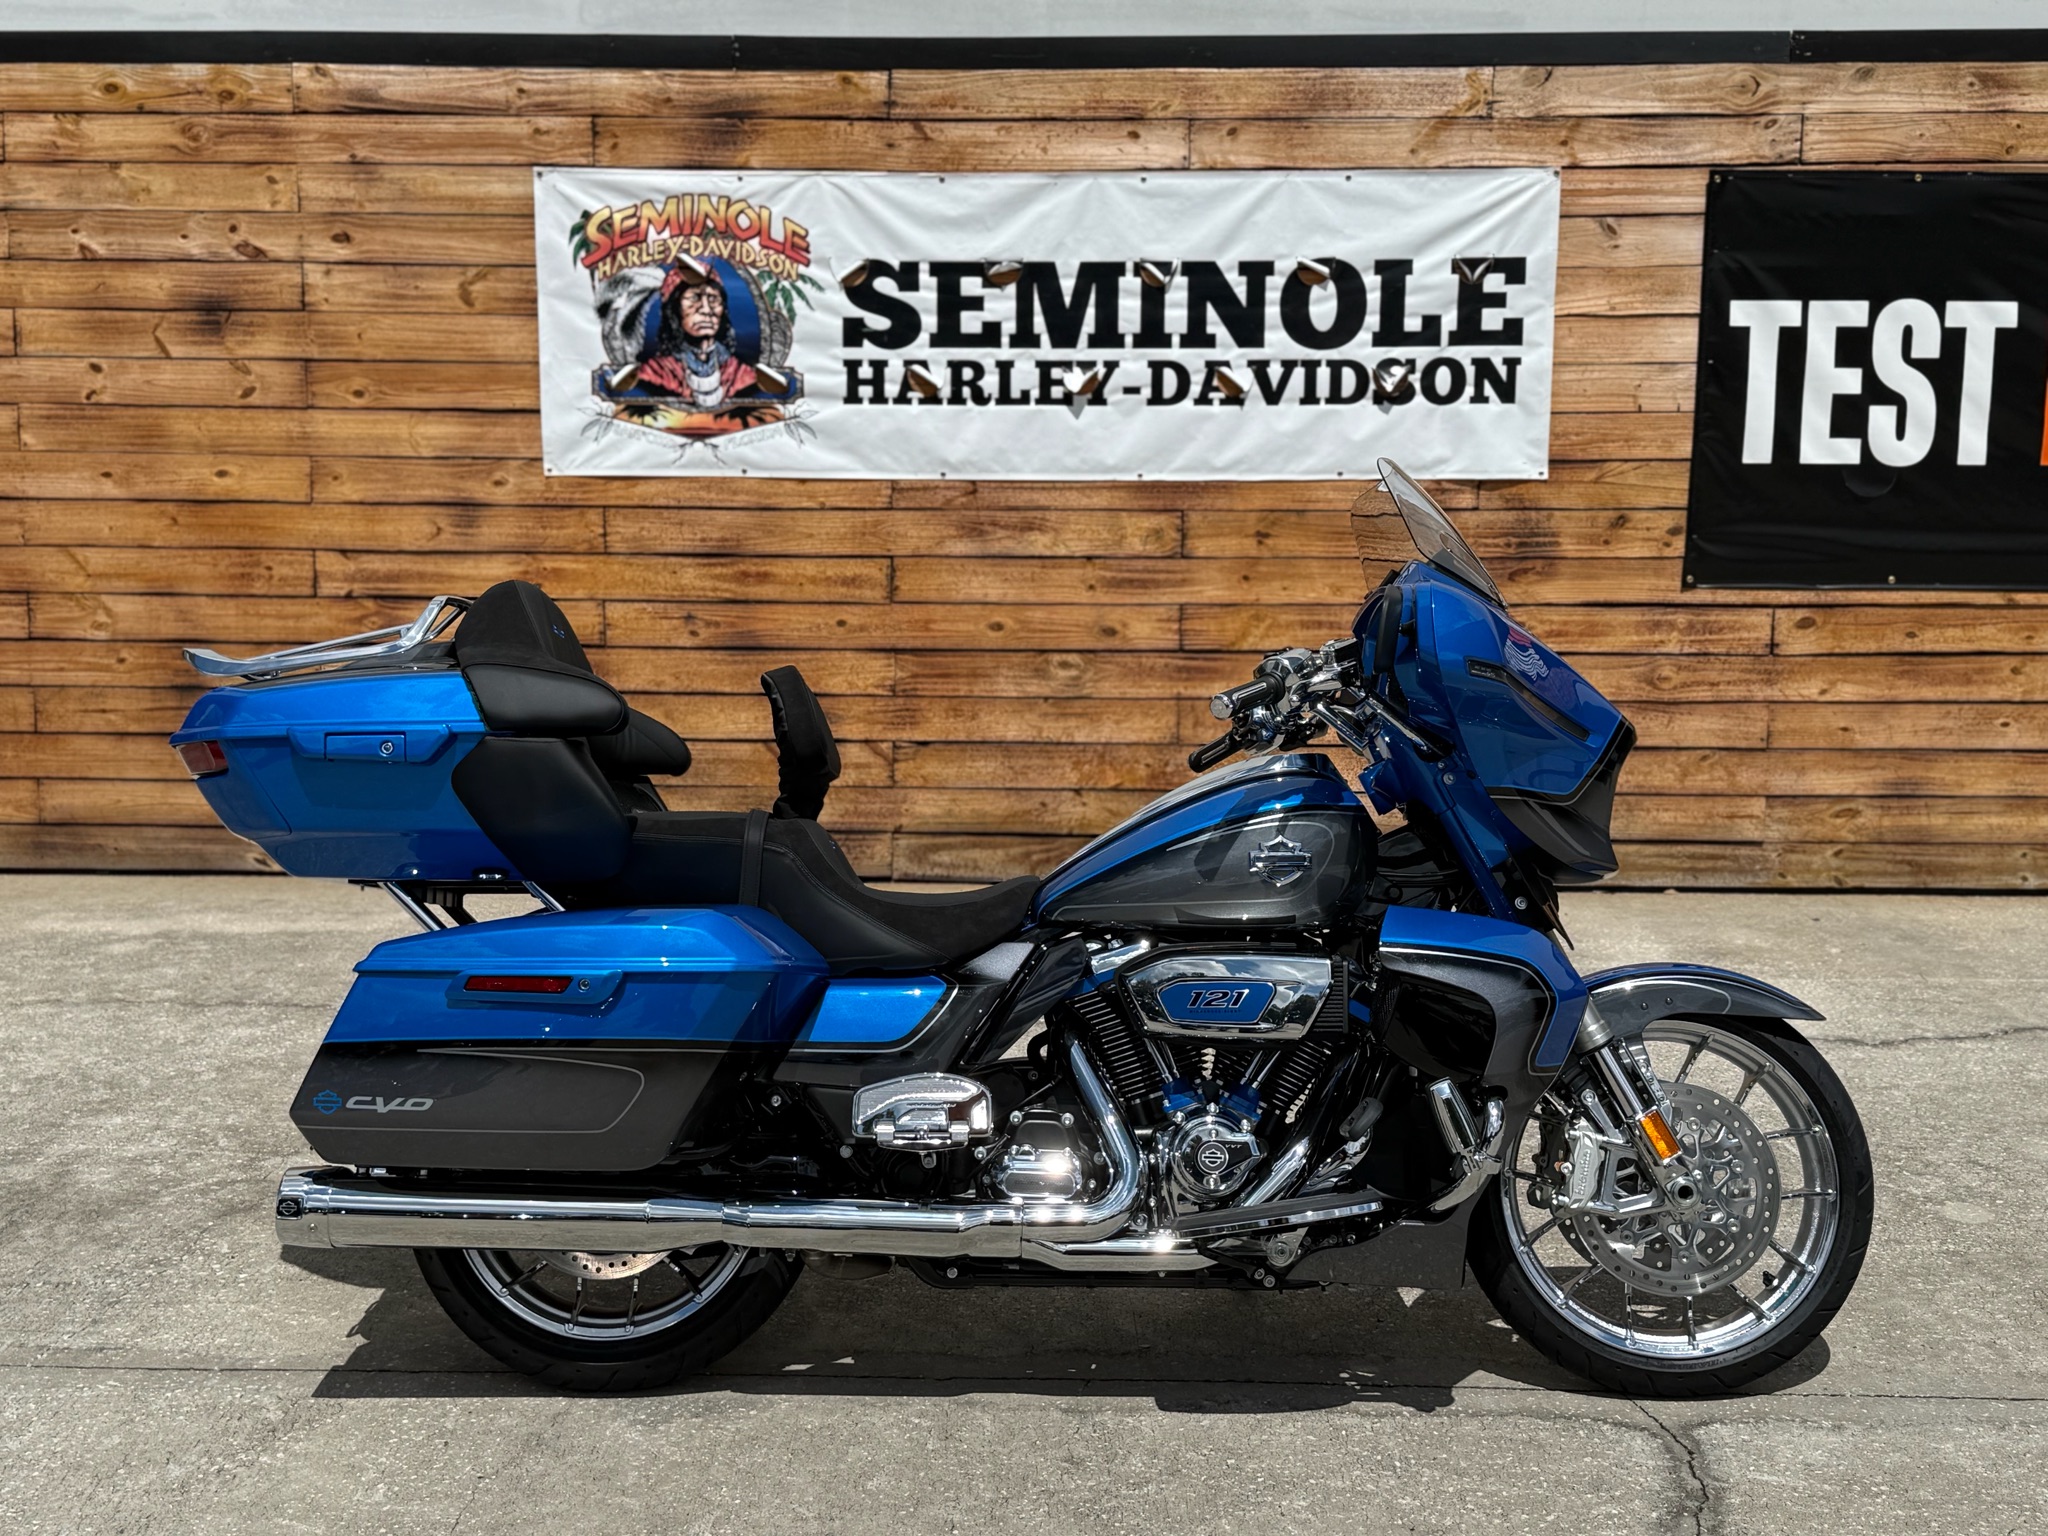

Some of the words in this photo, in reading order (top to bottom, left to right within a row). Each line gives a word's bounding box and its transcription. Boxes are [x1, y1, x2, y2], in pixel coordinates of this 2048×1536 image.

[581, 193, 811, 269] SEMINOLE
[597, 235, 799, 281] HARLEY-DAVIDSON
[842, 257, 1526, 350] SEMINOLE
[1729, 298, 2019, 467] TEST
[1187, 989, 1249, 1008] 121
[345, 1096, 434, 1113] CVO
